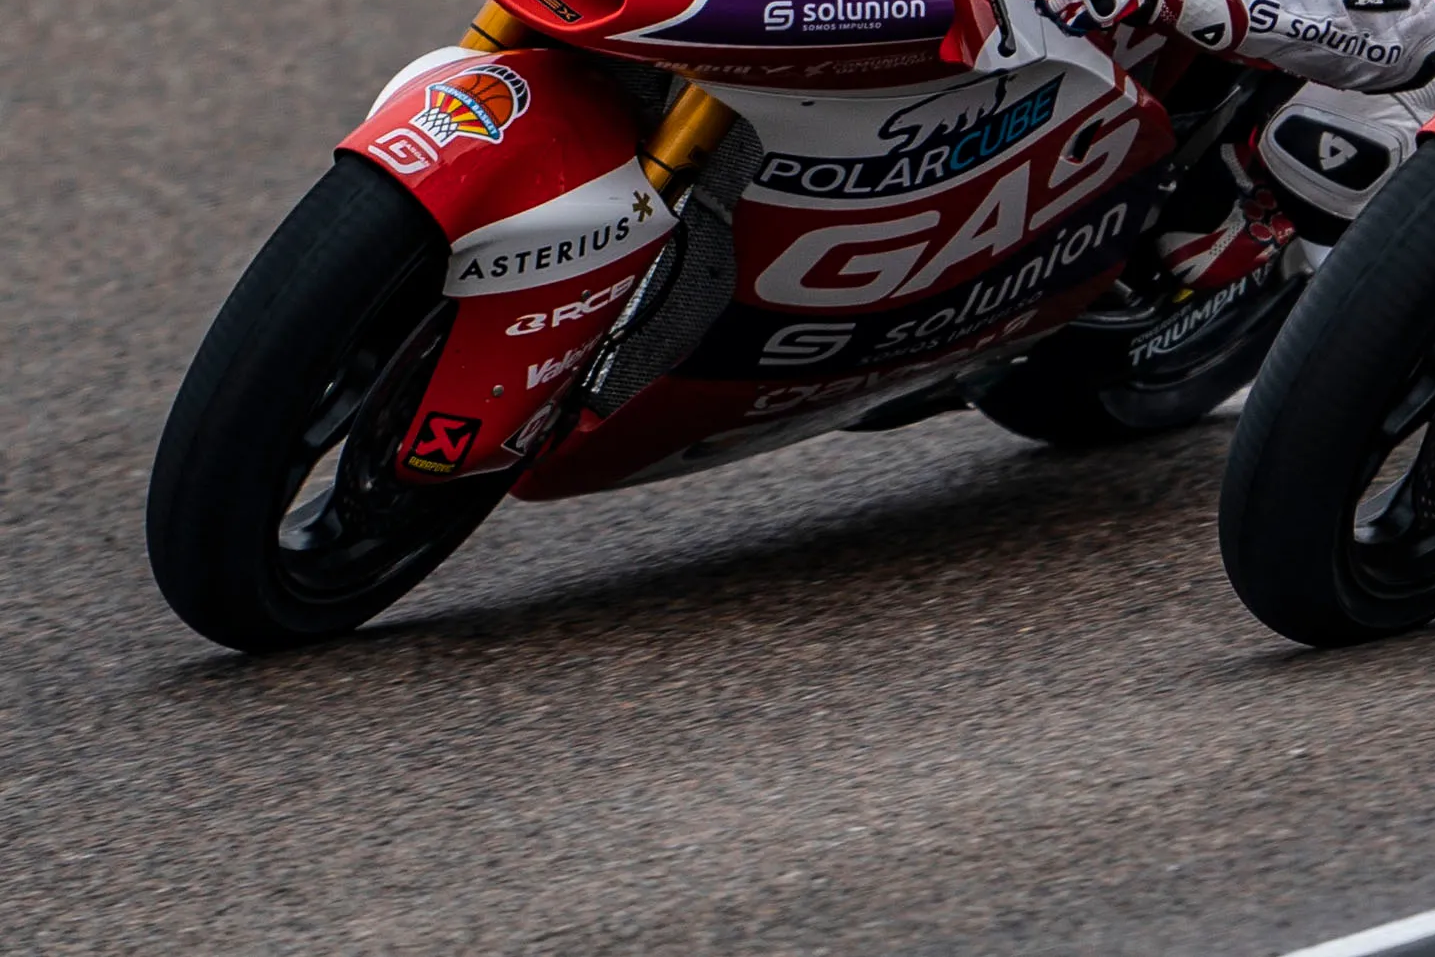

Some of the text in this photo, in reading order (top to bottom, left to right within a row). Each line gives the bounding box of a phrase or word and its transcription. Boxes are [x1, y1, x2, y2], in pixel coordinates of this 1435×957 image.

[802, 22, 883, 32] SOMOS IMPULSO
[1286, 18, 1402, 65] solunion
[759, 85, 1053, 193] POLARCUBE
[754, 93, 1140, 307] GAS
[458, 215, 630, 282] ASTERIUS
[874, 202, 1128, 351] solunion
[1128, 276, 1248, 367] TRIUMPH
